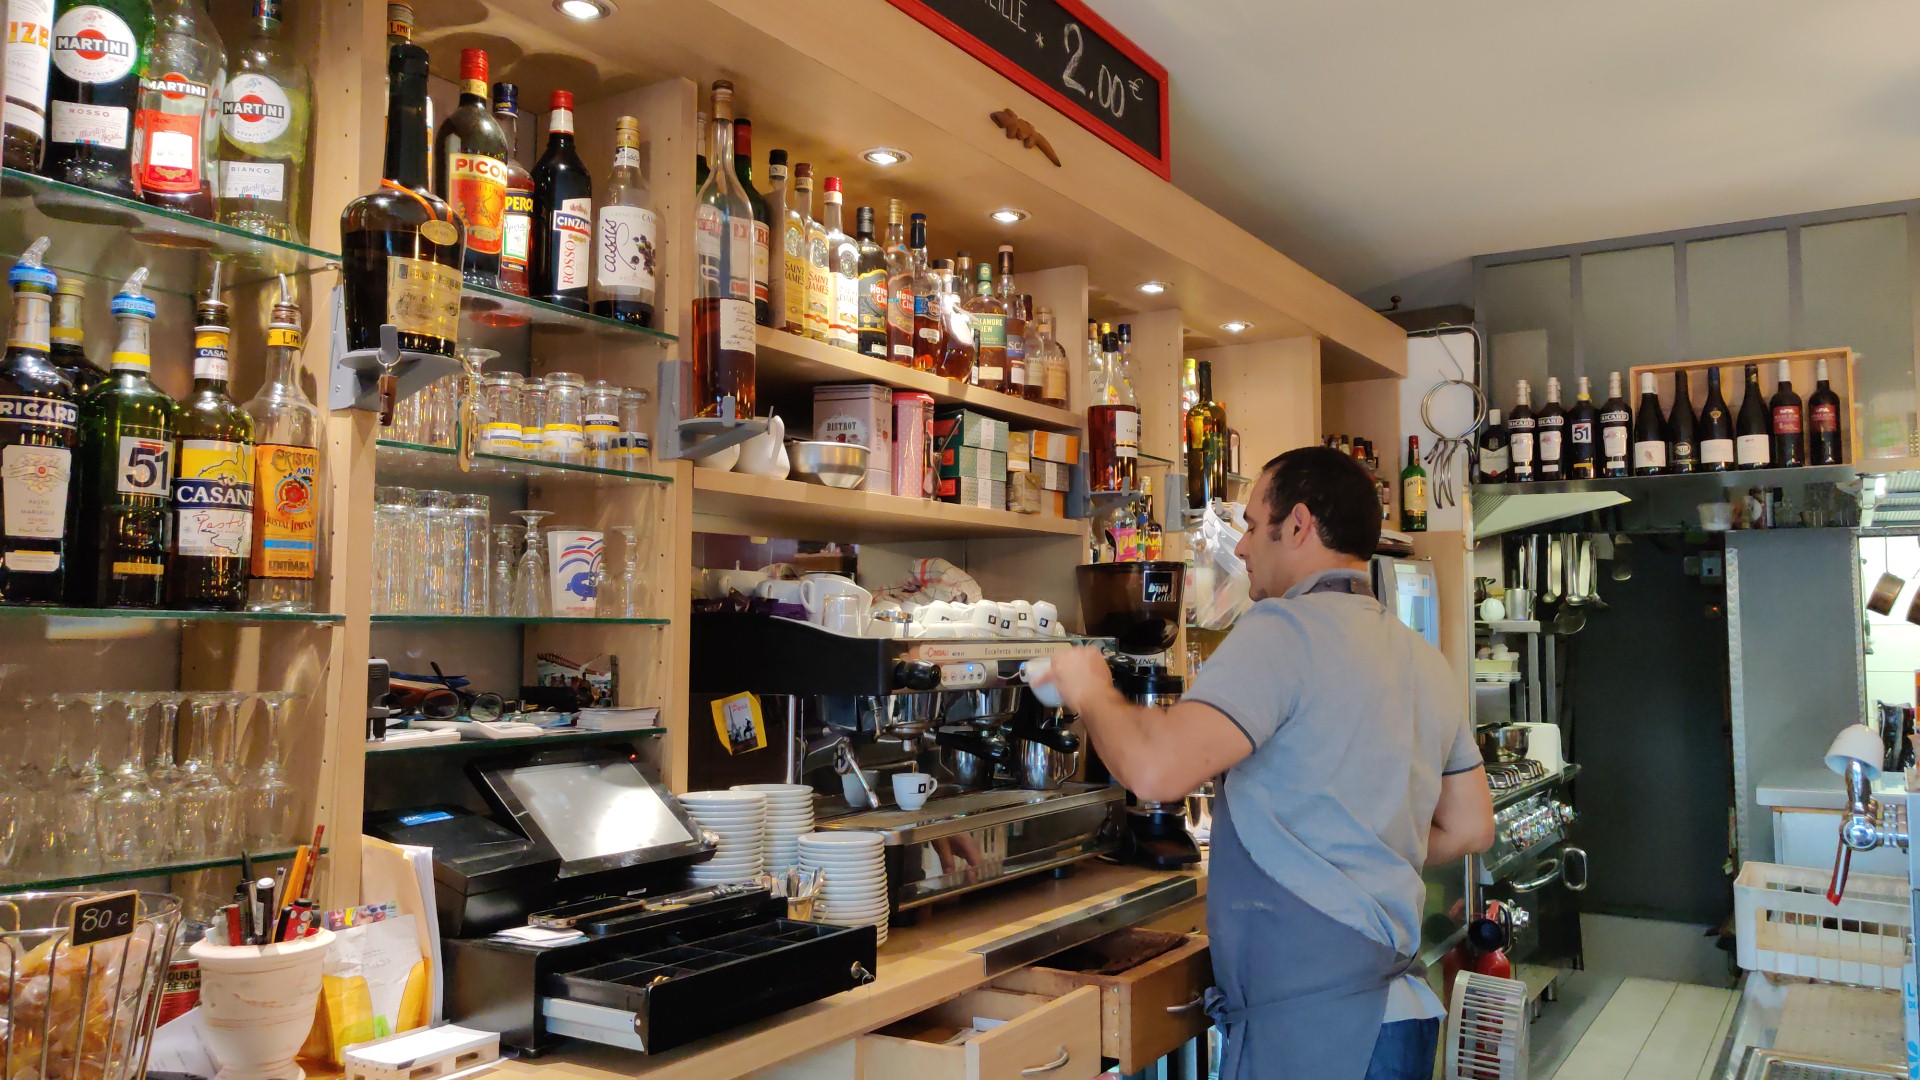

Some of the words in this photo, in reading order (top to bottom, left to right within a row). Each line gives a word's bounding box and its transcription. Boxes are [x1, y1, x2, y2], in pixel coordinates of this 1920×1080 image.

[57, 37, 127, 56] MARTINI
[149, 80, 207, 97] MARTINI
[68, 107, 110, 117] ROSSO
[224, 103, 284, 118] MARTINI
[230, 166, 271, 175] BIANCO
[504, 196, 534, 212] PERO
[562, 240, 577, 285] ROSSO
[807, 271, 829, 286] SAINT
[805, 281, 829, 296] JAMES
[0, 401, 77, 423] RICARD
[826, 421, 857, 432] BISTROT
[1573, 427, 1590, 442] 51
[126, 446, 169, 492] 51
[177, 485, 254, 506] CASANI
[81, 908, 113, 932] 80
